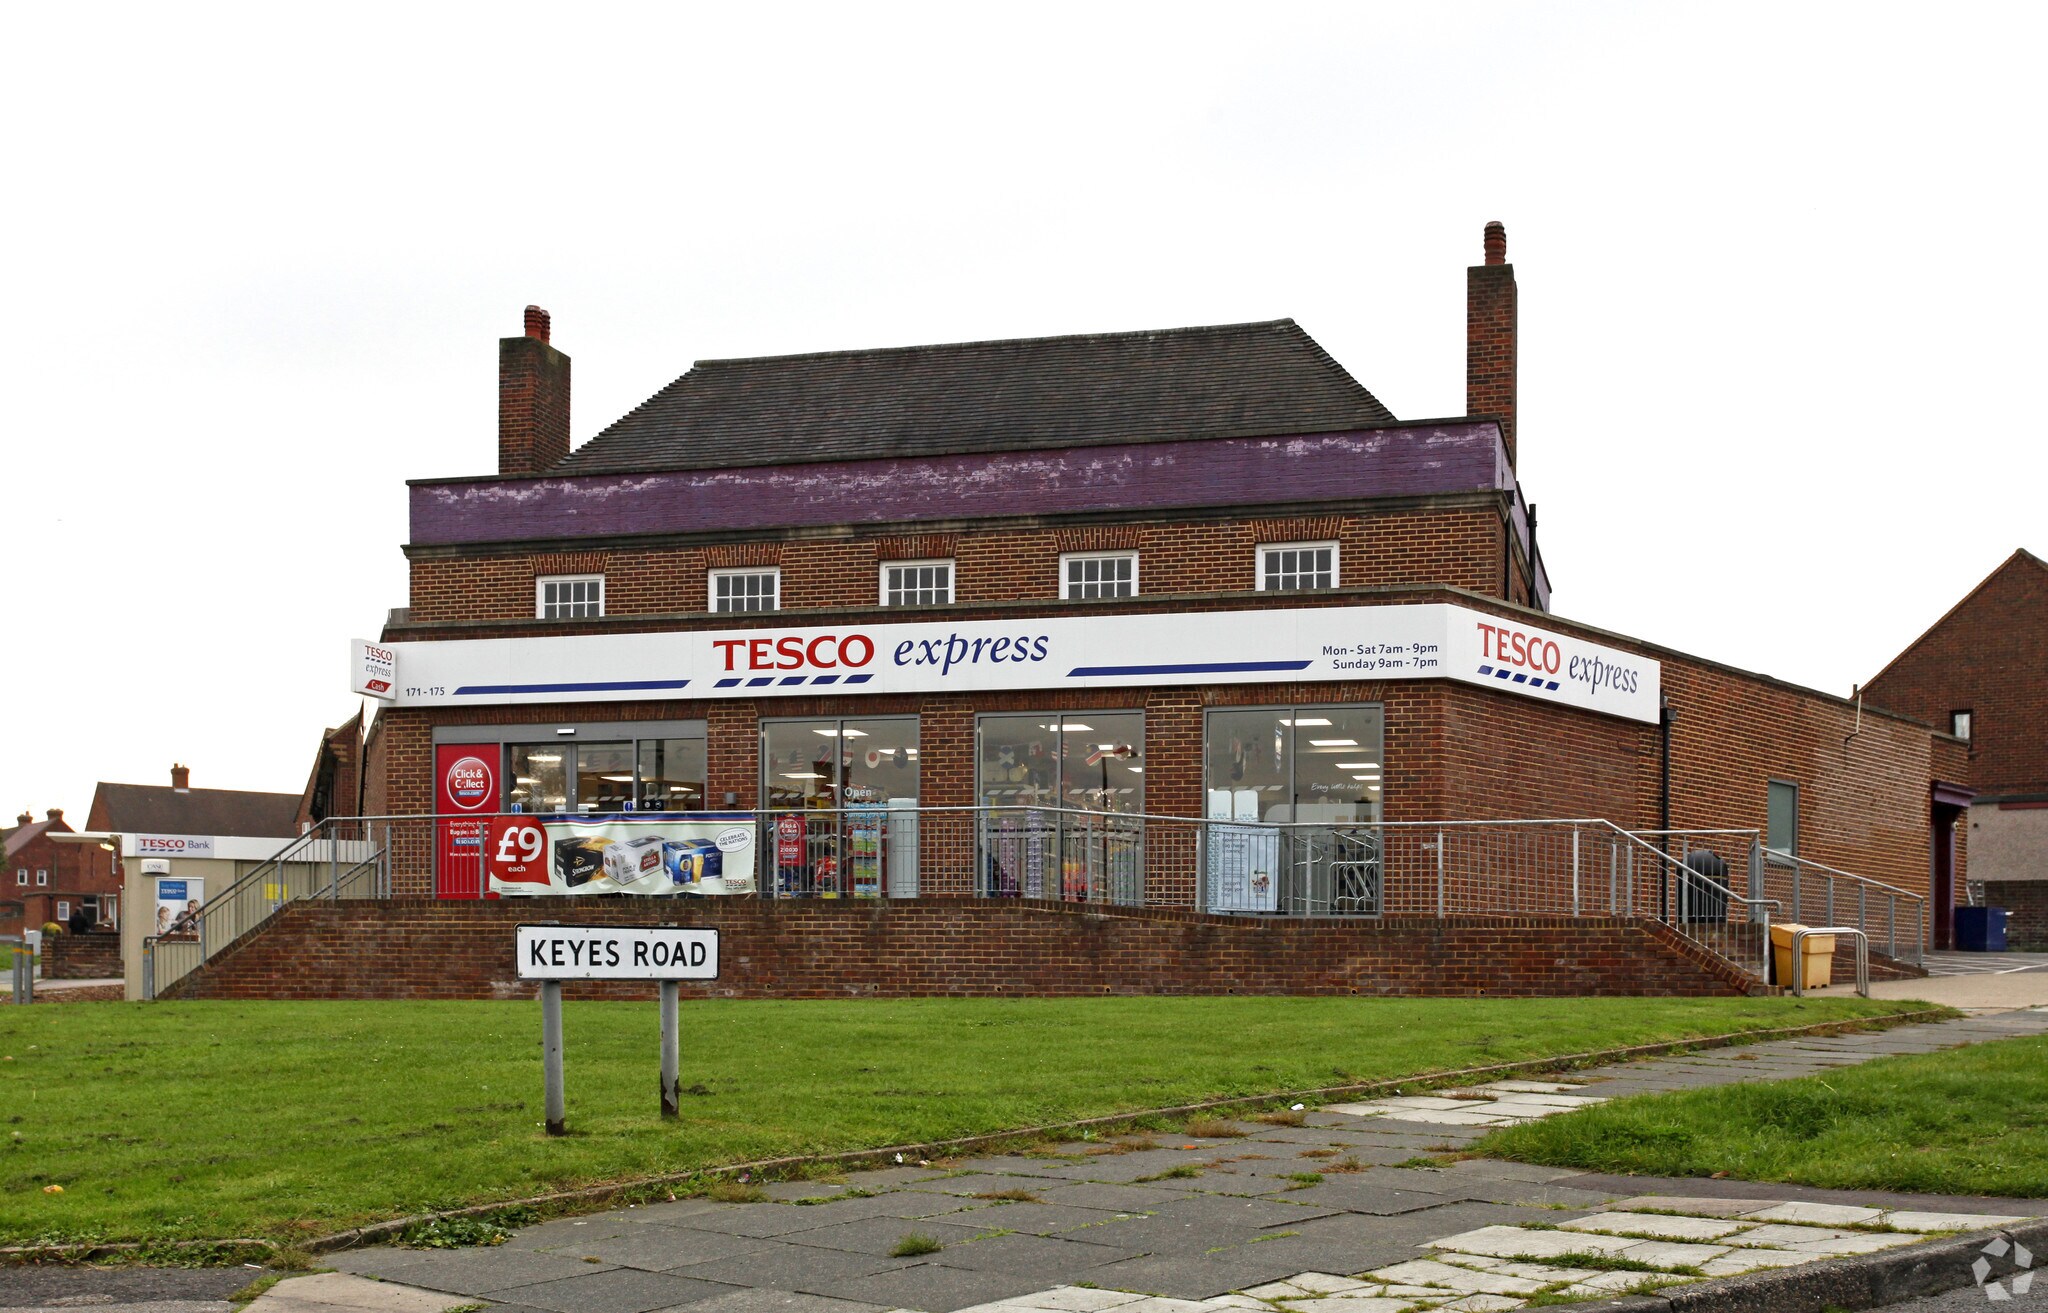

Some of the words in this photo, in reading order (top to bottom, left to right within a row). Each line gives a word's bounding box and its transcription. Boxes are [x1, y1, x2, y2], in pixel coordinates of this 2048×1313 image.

[364, 645, 392, 661] TESCO
[713, 634, 875, 671] TESCO
[893, 633, 1049, 676] express
[1322, 645, 1347, 655] Mon
[1357, 644, 1376, 655] Sat
[1379, 644, 1403, 654] 7am
[1413, 643, 1438, 655] 9pm
[1333, 659, 1376, 670] Sunday
[1379, 658, 1403, 668] 9am
[1413, 657, 1438, 669] 7pm
[1477, 623, 1560, 675] TESCO
[1569, 655, 1638, 694] express
[365, 664, 391, 677] express
[371, 682, 385, 691] Cash
[406, 688, 421, 696] 171
[430, 687, 445, 696] 175
[455, 769, 475, 779] Click
[476, 769, 483, 779] &
[844, 786, 872, 799] Open
[1311, 782, 1328, 792] Every
[720, 832, 745, 843] CELEBRATE
[729, 836, 748, 845] NATIONS
[140, 839, 185, 848] TESCO
[188, 841, 210, 849] Bank
[496, 826, 543, 862] £9
[531, 940, 620, 966] KEYES
[634, 941, 707, 967] ROAD
